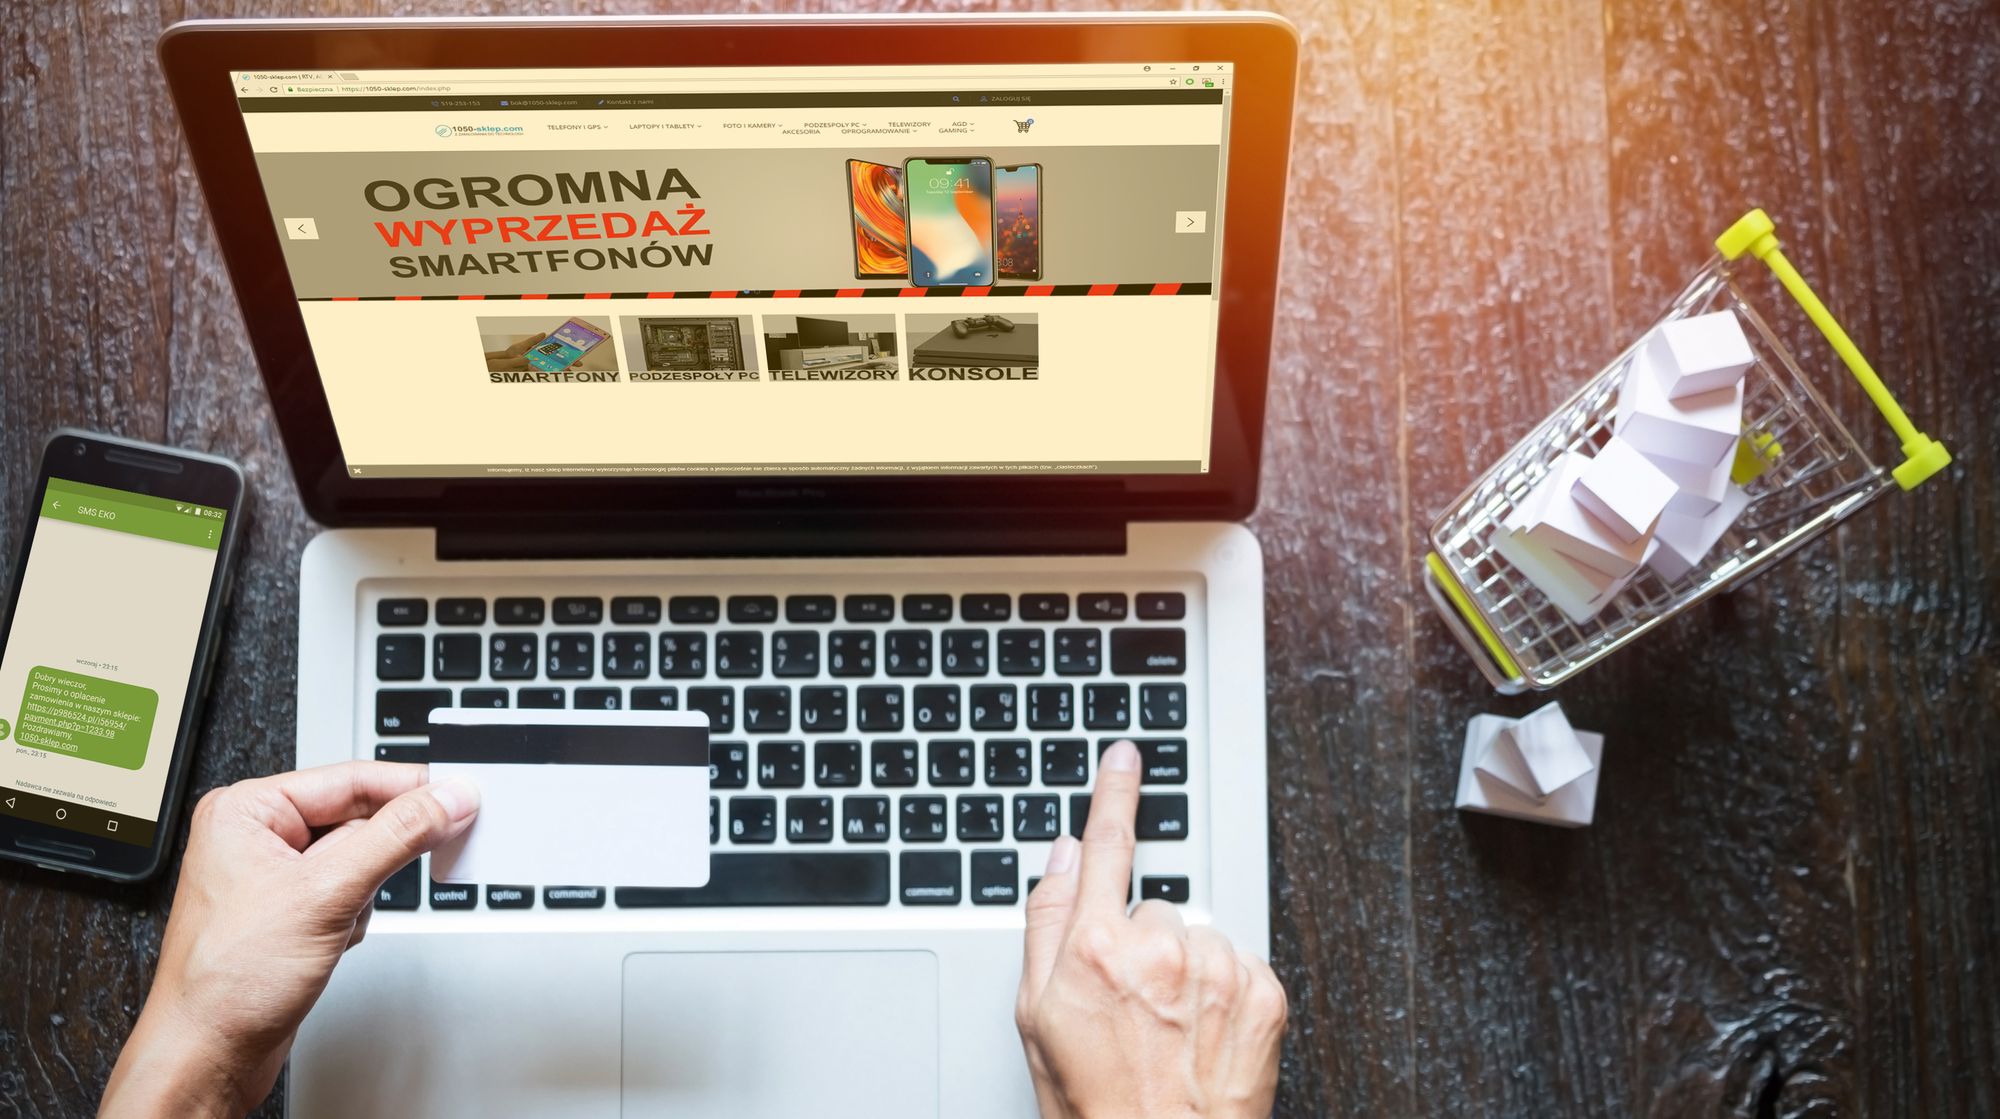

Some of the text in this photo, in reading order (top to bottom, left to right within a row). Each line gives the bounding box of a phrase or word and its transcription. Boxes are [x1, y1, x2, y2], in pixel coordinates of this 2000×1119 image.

[297, 86, 333, 94] Bezpieczna
[452, 125, 524, 134] 1050-sklep.com
[363, 167, 701, 212] OGROMNA
[929, 177, 970, 189] 09:41
[374, 202, 711, 248] WYPRZEDAŻ
[389, 240, 714, 278] SMARTFONÓW
[490, 371, 620, 383] SMARTFONY
[629, 371, 760, 381] PODZESPOŁY PC
[769, 369, 898, 381] TELEWIZORY
[909, 367, 1038, 381] KONSOLE
[78, 505, 116, 520] SMS EKO
[203, 508, 222, 519] 08:32
[76, 659, 98, 669] wczoraj
[494, 657, 504, 671] 2
[551, 657, 560, 671] 3
[607, 656, 618, 671] 4
[664, 657, 674, 670] 5
[720, 657, 730, 670] 6
[777, 655, 786, 669] 7
[834, 655, 843, 669] 8
[891, 654, 900, 667] 9
[1146, 655, 1178, 667] delete
[34, 671, 56, 685] Dobry
[32, 681, 63, 696] Prosimy
[83, 703, 112, 718] naszym
[113, 709, 141, 723] sklepie:
[749, 709, 760, 724] Y
[805, 709, 817, 724] U
[919, 708, 932, 723] O
[975, 708, 986, 722] P
[383, 717, 400, 728] tab
[22, 721, 73, 741] Pozdrawiamy,
[19, 731, 78, 752] 1050-sklep.com
[762, 765, 775, 779] H
[819, 764, 828, 779] J
[875, 763, 887, 778] K
[932, 763, 941, 777] L
[1150, 766, 1180, 777] return
[15, 779, 118, 809] Nadawca nie zezwala na odpowiedzi
[733, 819, 744, 835] B
[791, 819, 803, 834] N
[848, 819, 863, 834] M
[1158, 819, 1181, 831] shift
[381, 889, 391, 901] fn
[434, 889, 467, 901] control
[491, 889, 522, 902] option
[548, 888, 598, 900] command
[905, 885, 954, 897] command
[982, 885, 1013, 898] option
